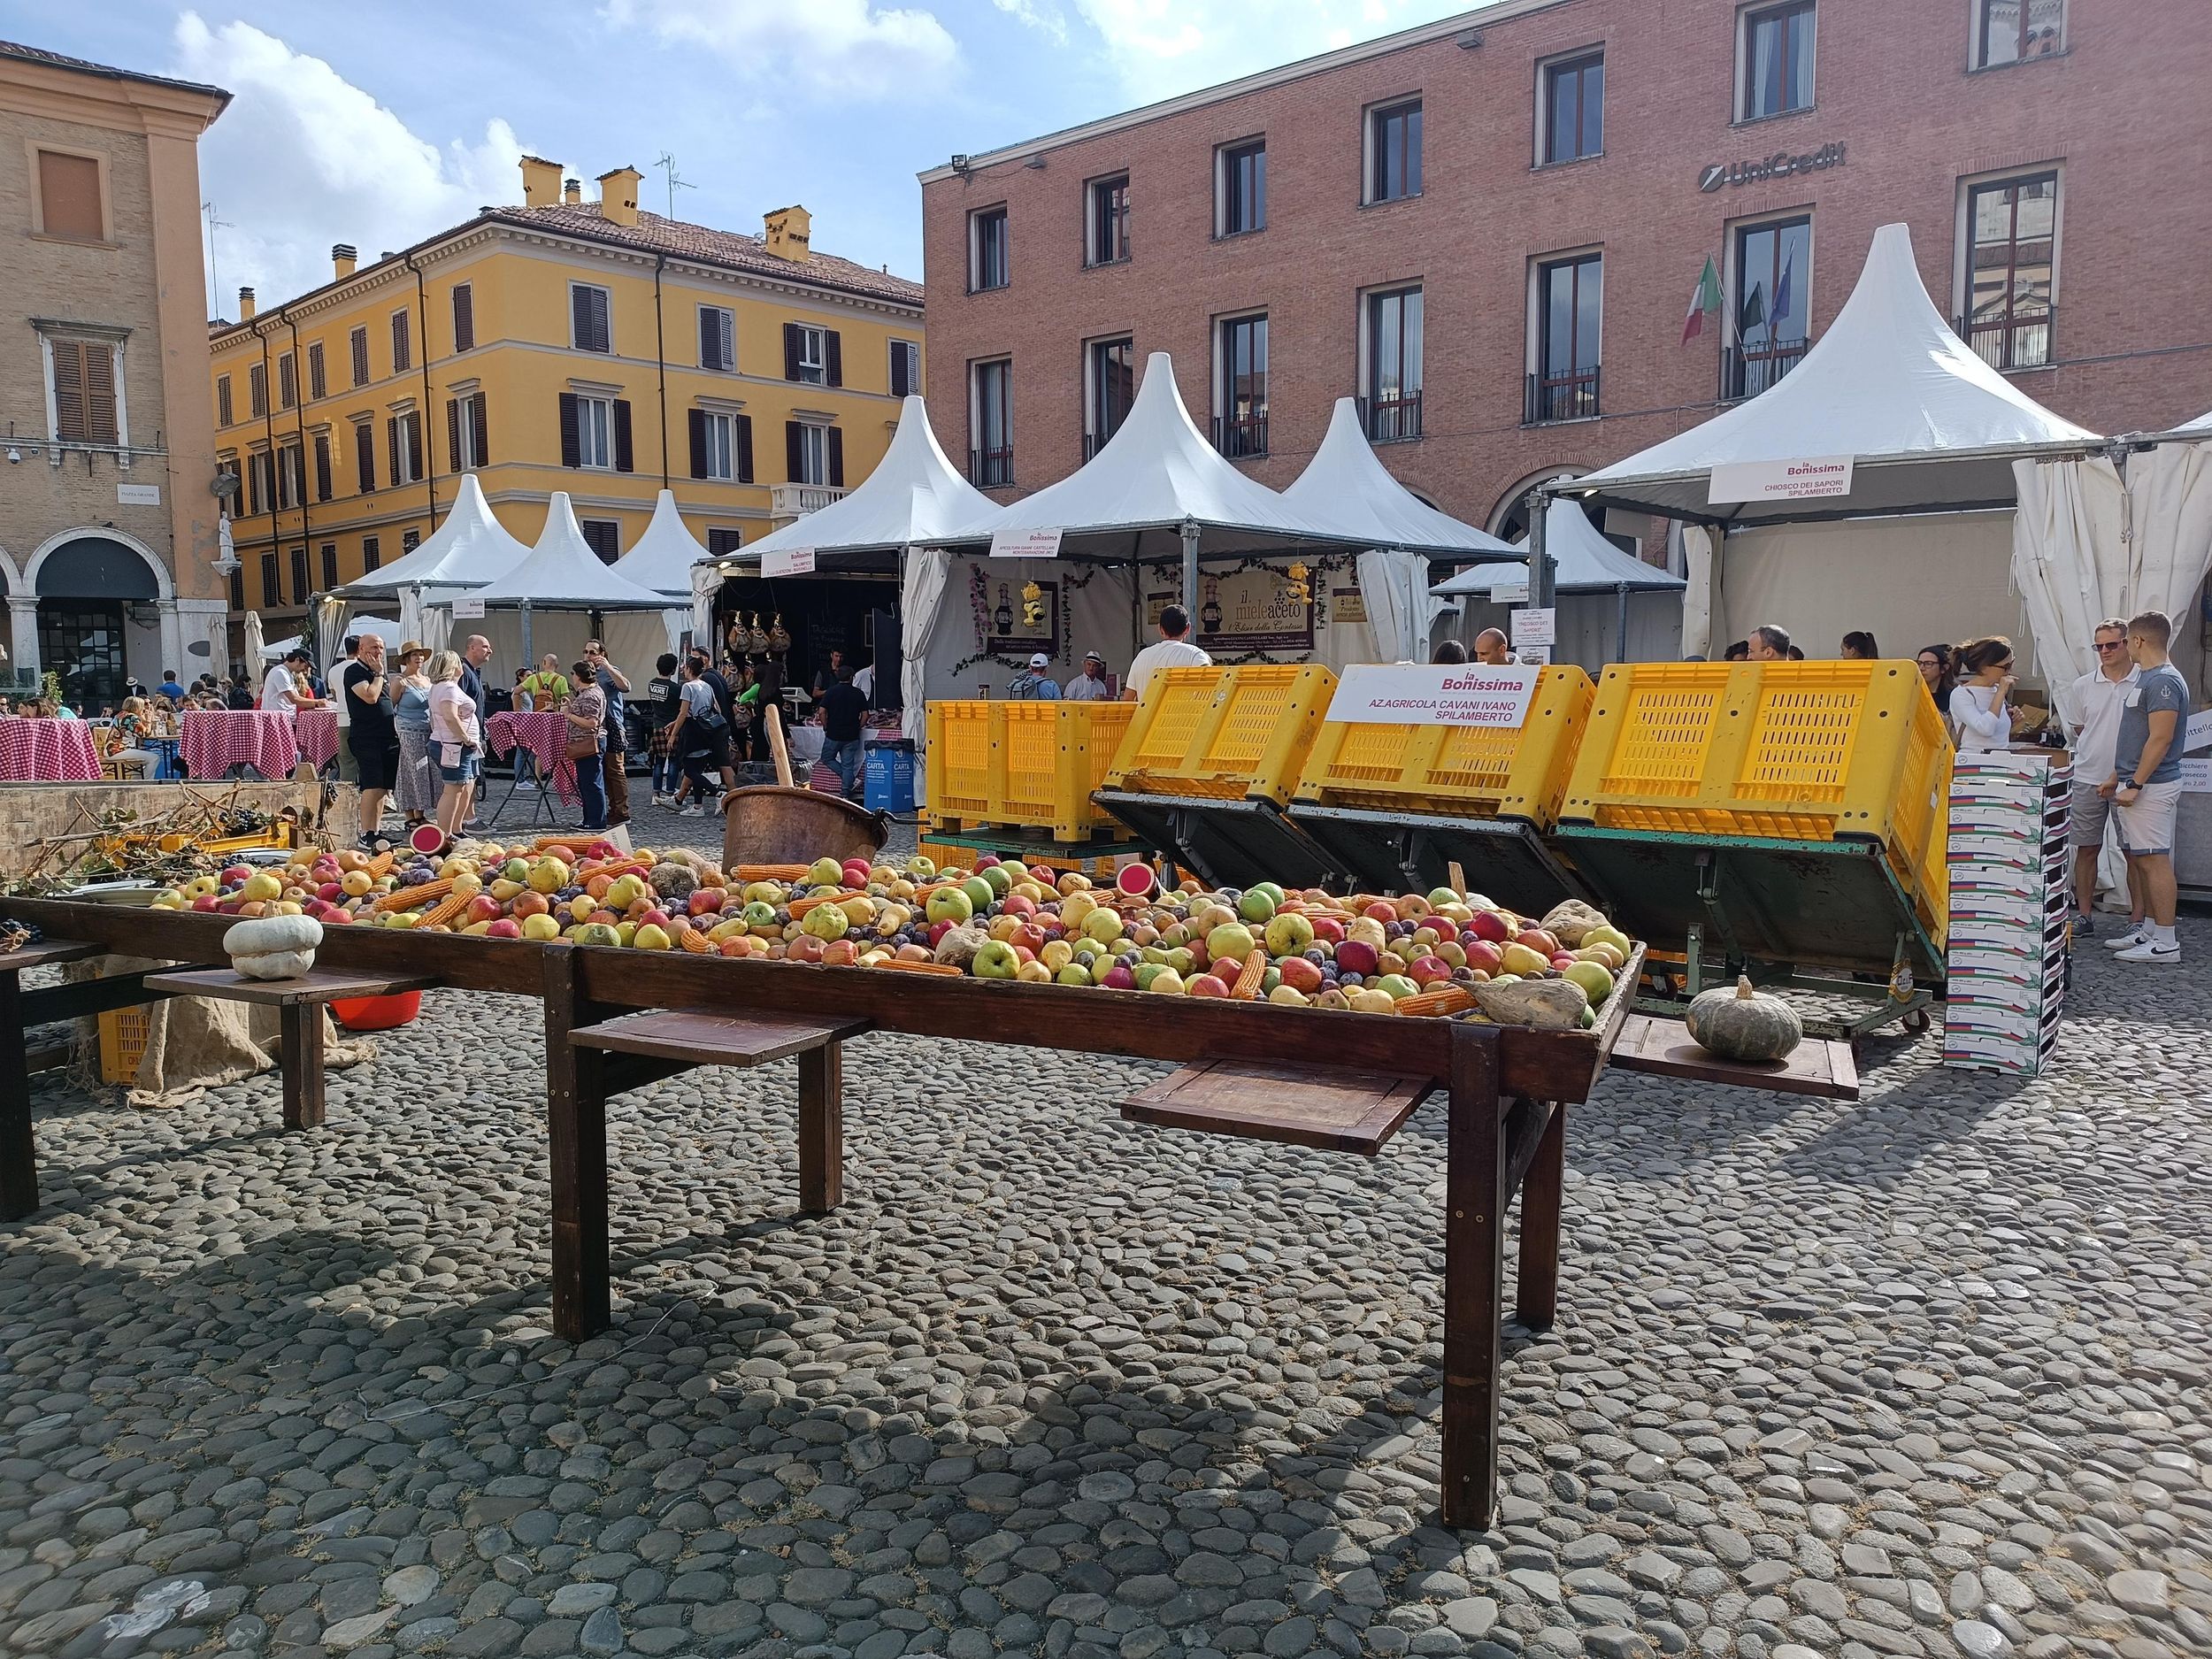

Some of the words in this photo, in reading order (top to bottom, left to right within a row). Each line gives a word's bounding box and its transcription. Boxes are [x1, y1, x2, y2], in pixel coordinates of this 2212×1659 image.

[1730, 141, 1846, 187] UniCredit
[1788, 465, 1845, 475] Bonissima
[1788, 487, 1842, 496] SPILAMBERTO
[1241, 589, 1248, 603] il
[1236, 600, 1301, 619] mieleaceto
[650, 685, 665, 695] VANS
[1441, 679, 1524, 691] Bonissima
[1369, 699, 1437, 709] AZ.AGRICOLA
[1439, 700, 1480, 710] CAVANI
[1481, 702, 1517, 710] IVANO
[1434, 710, 1513, 722] SPILAMBERTO
